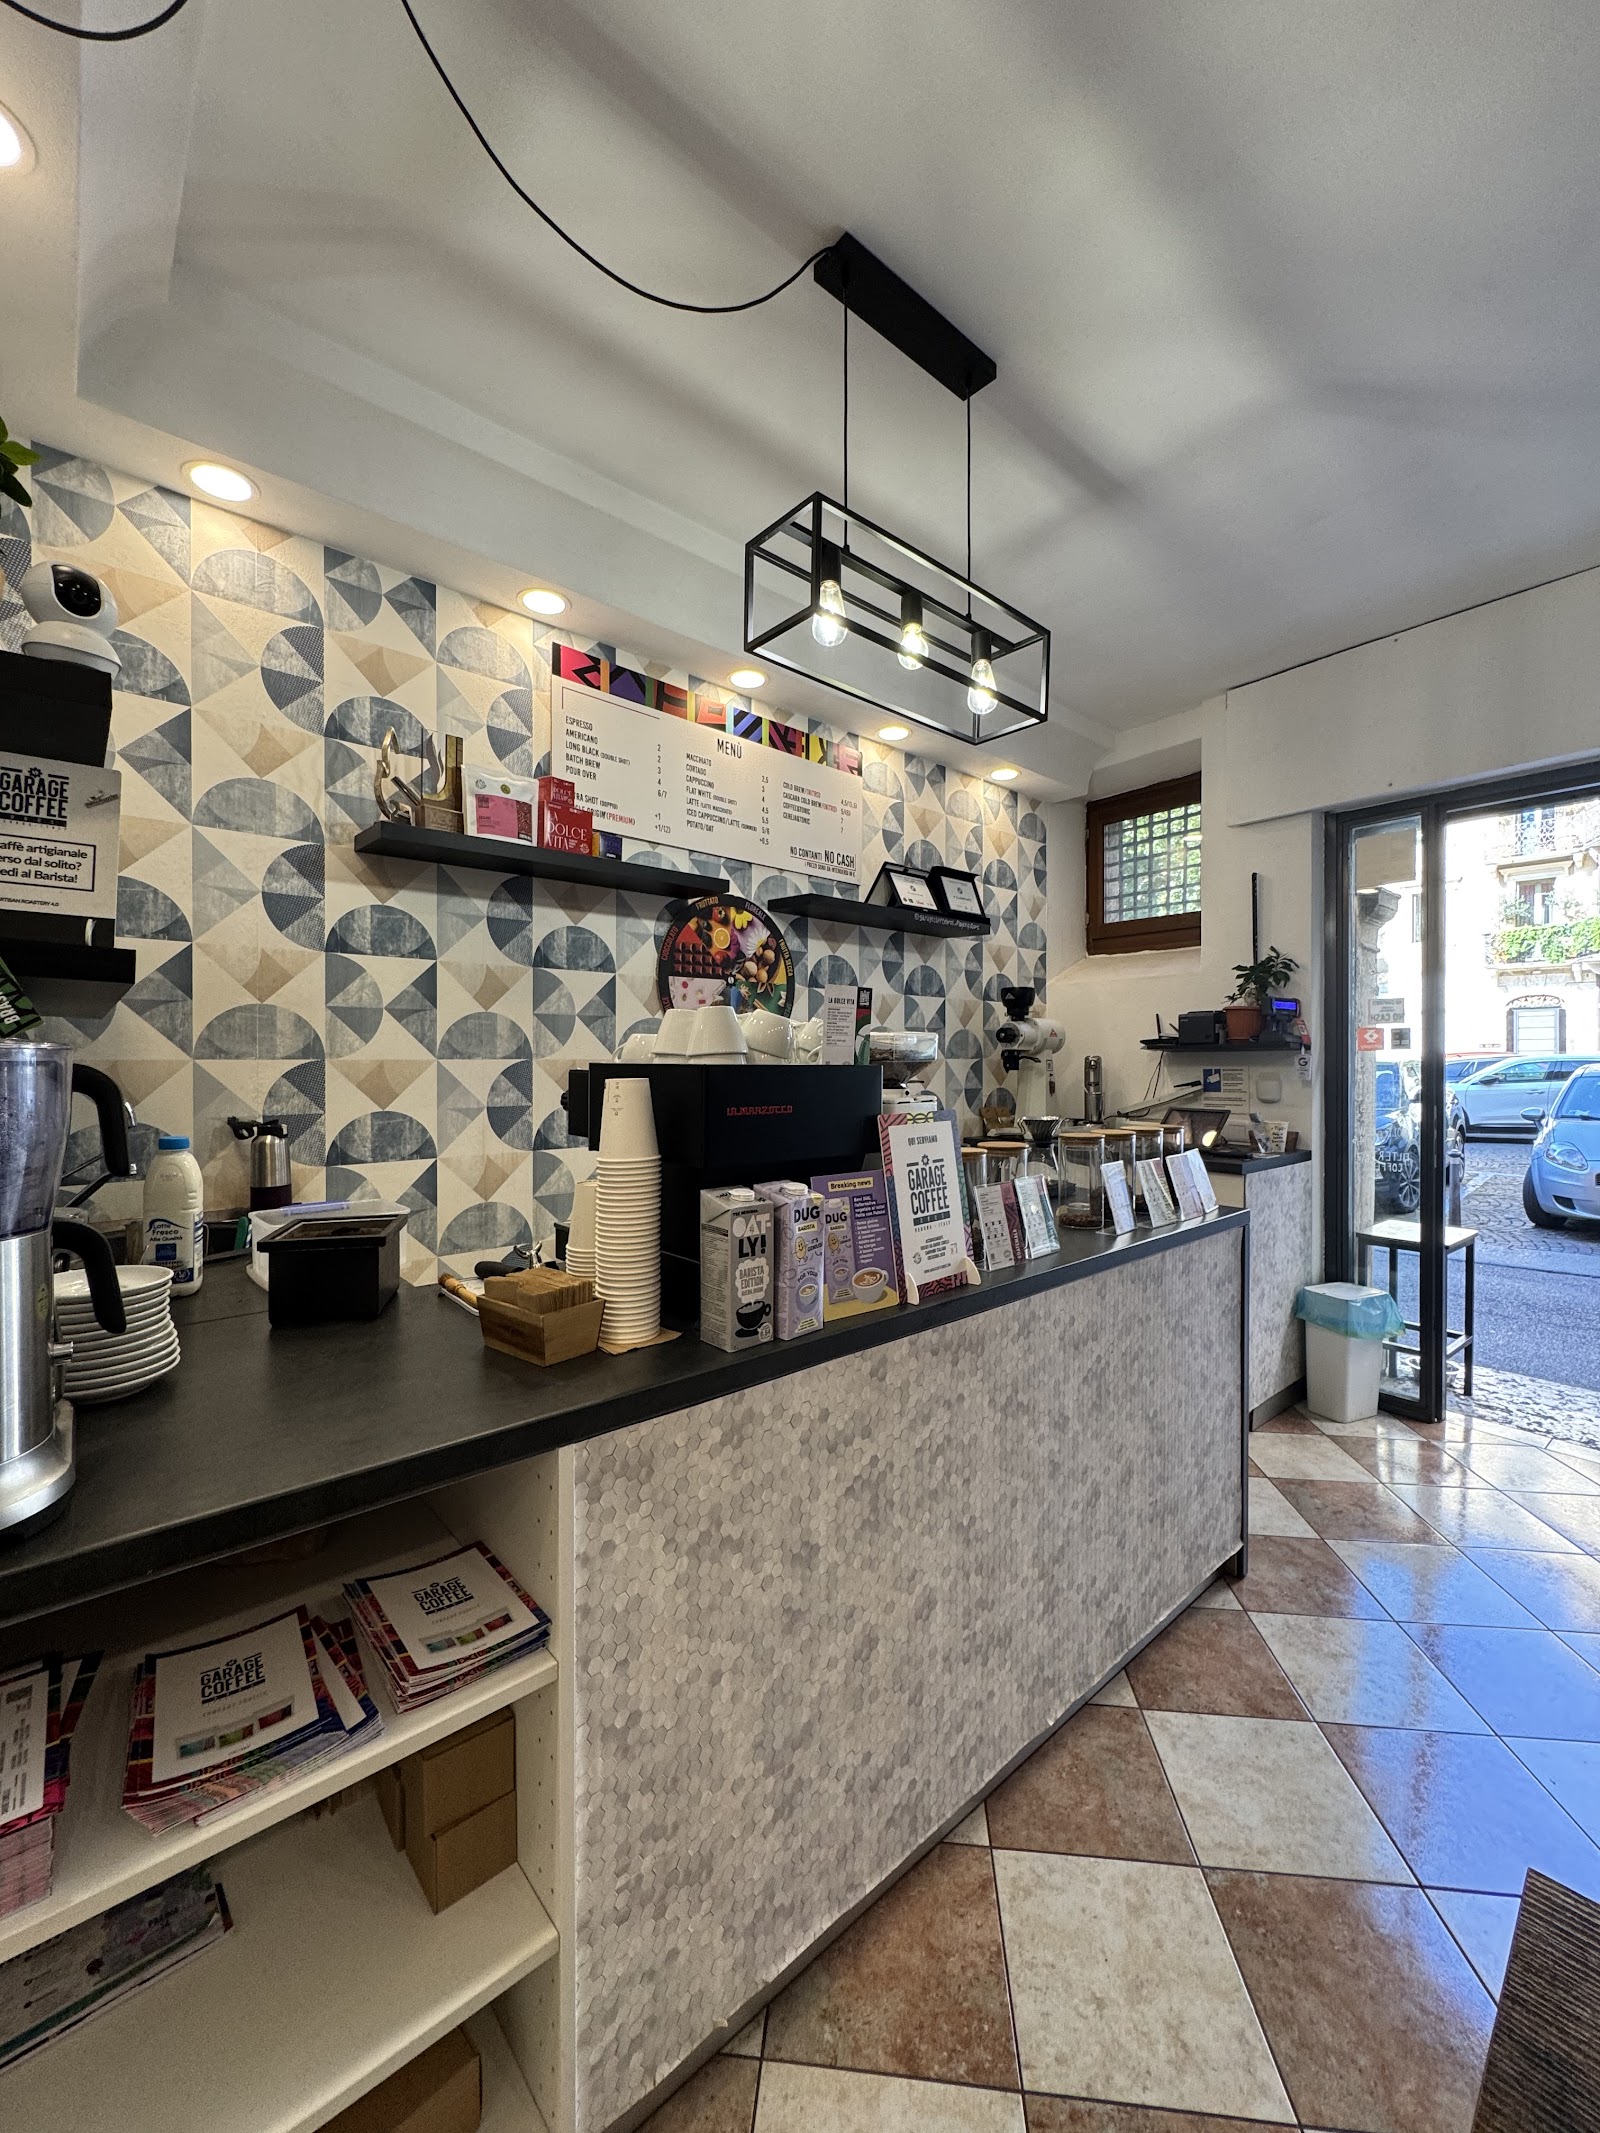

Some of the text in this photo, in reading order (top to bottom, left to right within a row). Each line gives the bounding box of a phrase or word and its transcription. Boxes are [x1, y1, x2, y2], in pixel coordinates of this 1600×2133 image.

[565, 715, 593, 731] ESPRESSO
[565, 728, 598, 745] AMERICANO
[565, 740, 580, 752] LONG
[582, 745, 600, 757] BLACK
[657, 744, 661, 752] 2
[717, 738, 742, 759] MENÙ
[565, 753, 601, 769] BATCH BREW
[657, 755, 661, 763] 2
[686, 752, 712, 767] MACCHIATO
[565, 765, 597, 780] POUR OVER
[657, 767, 661, 775] 3
[685, 763, 707, 776] CORTADO
[0, 771, 69, 800] GARAGE
[657, 778, 662, 786] 4
[685, 774, 715, 789] CAPPUCCINO
[584, 794, 599, 805] SHOT
[686, 785, 697, 796] FLAT
[697, 789, 712, 800] WHITE
[0, 790, 69, 819] COFFEE
[686, 796, 700, 807] LATTE
[686, 808, 697, 818] ICED
[549, 821, 589, 841] DOLCE
[0, 841, 88, 859] affè artigianale
[790, 846, 855, 869] NO CONTANTI NO CASH
[24, 856, 42, 867] dal
[44, 859, 82, 871] solito?
[0, 867, 78, 884] edi al Barista!
[695, 895, 719, 910] FRUTTATO
[744, 901, 767, 921] FLOREALE
[661, 925, 679, 961] CIOCCOLATO
[1298, 1057, 1308, 1067] G
[907, 1135, 938, 1147] QUI SERVIAMO
[830, 1178, 872, 1191] Breaking news
[907, 1164, 947, 1191] GARAGE
[910, 1186, 950, 1216] COFFEE
[793, 1206, 820, 1223] DUG
[825, 1211, 848, 1224] DUG
[738, 1234, 767, 1259] LY!
[739, 1264, 765, 1279] BARISTA
[740, 1275, 764, 1290] EDITION
[413, 1579, 466, 1602] GARAGE
[419, 1588, 472, 1611] COFFEE
[200, 1656, 264, 1686] GARAGE
[201, 1670, 266, 1698] COFFEE
